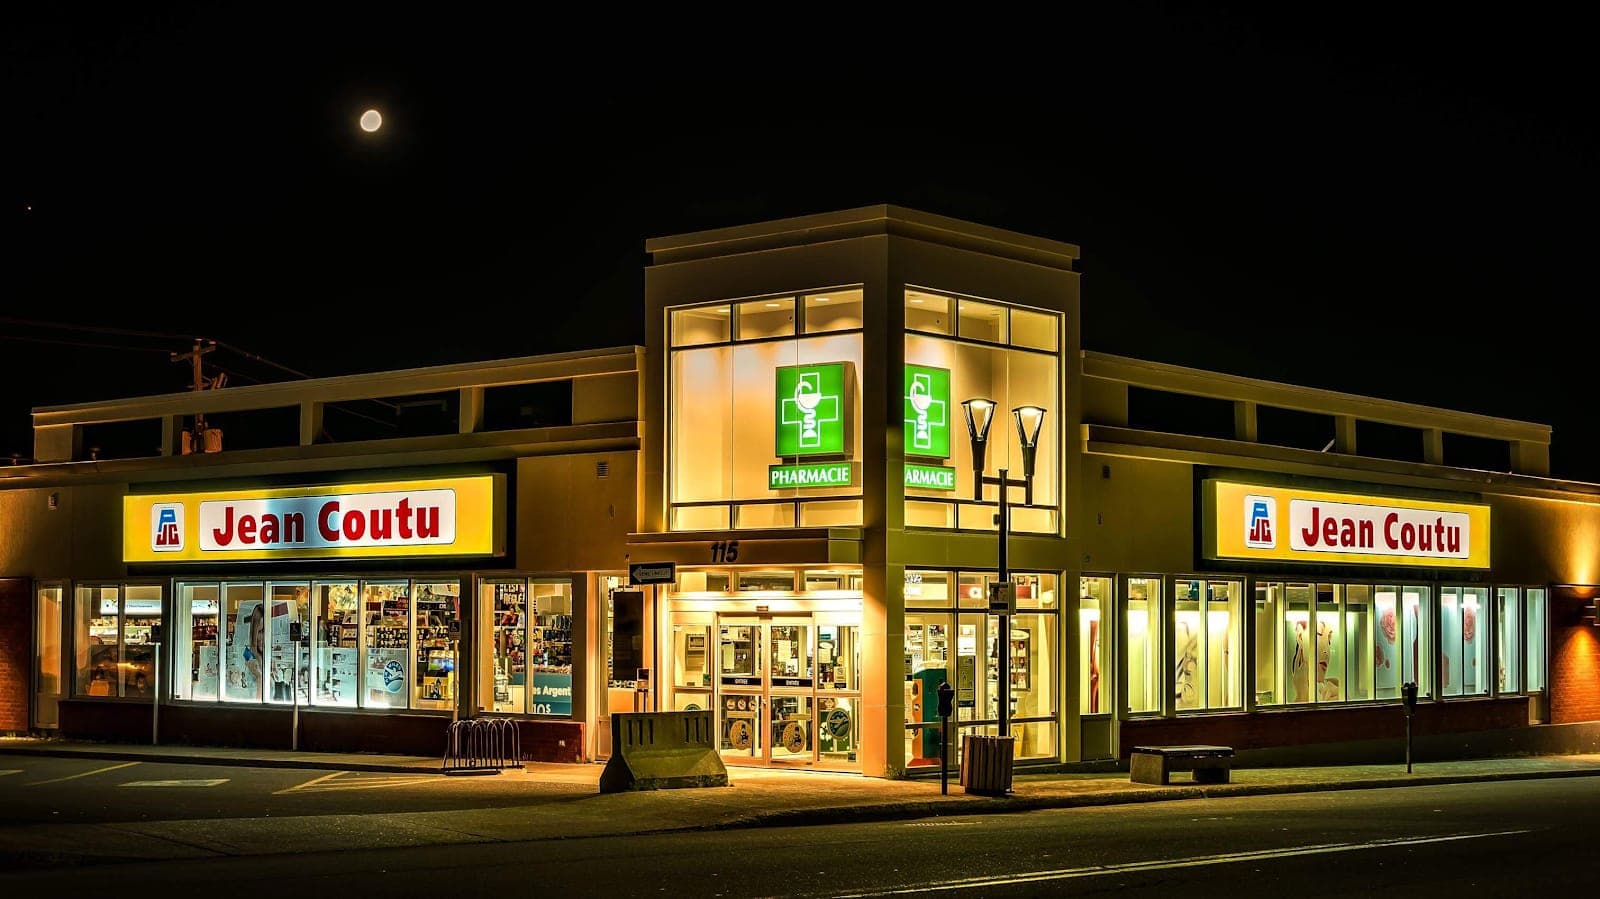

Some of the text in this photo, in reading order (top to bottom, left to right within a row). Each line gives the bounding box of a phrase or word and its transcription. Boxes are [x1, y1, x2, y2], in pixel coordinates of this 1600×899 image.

[771, 467, 849, 485] PHARMACIE
[904, 469, 954, 486] ARMACIE
[212, 497, 440, 546] Jean Coutu
[1301, 507, 1461, 553] Jean Coutu
[710, 540, 739, 563] 115
